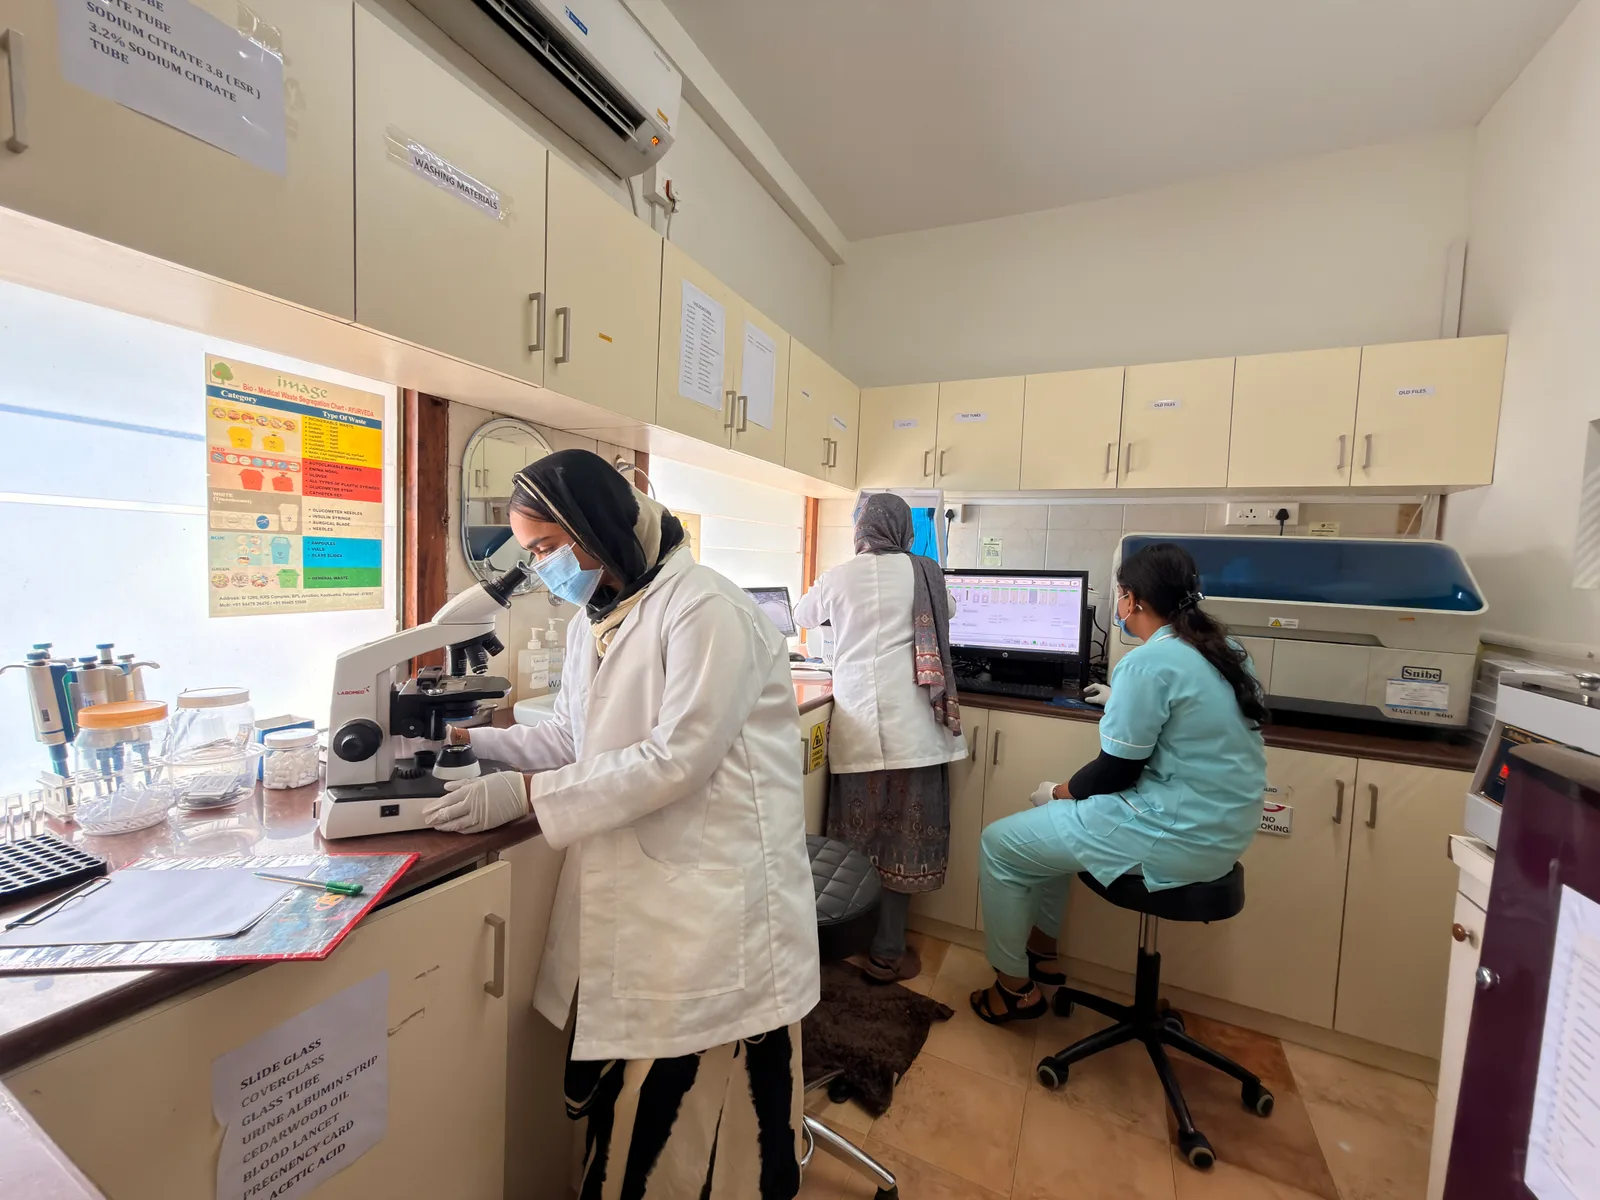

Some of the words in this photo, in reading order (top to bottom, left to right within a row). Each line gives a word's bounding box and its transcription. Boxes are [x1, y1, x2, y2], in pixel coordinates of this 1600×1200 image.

[135, 7, 171, 34] TUBE
[87, 2, 144, 38] SODIUM
[148, 34, 203, 68] CITRATE
[233, 78, 254, 95] ESR
[89, 21, 126, 48] 3.2%
[128, 42, 181, 75] SODIUM
[185, 70, 236, 102] CITRATE
[90, 38, 129, 64] TUBE
[415, 157, 455, 185] WASHING
[457, 181, 497, 210] MATERIALS
[221, 390, 257, 404] Category
[243, 383, 253, 391] Bio
[258, 387, 280, 398] Medical
[281, 392, 298, 401] Waste
[299, 396, 330, 408] Segregation
[331, 402, 344, 411] Chart
[348, 407, 374, 417] AYURVEDA
[278, 376, 328, 399] image
[322, 411, 338, 419] Type
[349, 416, 366, 425] Waste
[1404, 669, 1440, 679] Snibe
[1261, 823, 1289, 833] OKING
[240, 1062, 280, 1090] SLIDE
[283, 1038, 321, 1066] GLASS
[241, 1054, 324, 1108] COVERGLASS
[242, 1113, 284, 1144] URINE
[287, 1076, 344, 1118] ALBUMIN
[346, 1055, 378, 1081] STRIP
[242, 1096, 283, 1127] GLASS
[286, 1073, 320, 1100] TUBE
[243, 1104, 327, 1163] CEDARWOOD
[330, 1090, 350, 1106] OIL
[243, 1147, 289, 1183] BLOOD
[293, 1112, 339, 1150] LANCET
[243, 1141, 321, 1200] PREGNENCY
[323, 1120, 354, 1145] CARD
[269, 1163, 314, 1200] ACETIC
[317, 1143, 345, 1168] ACID
